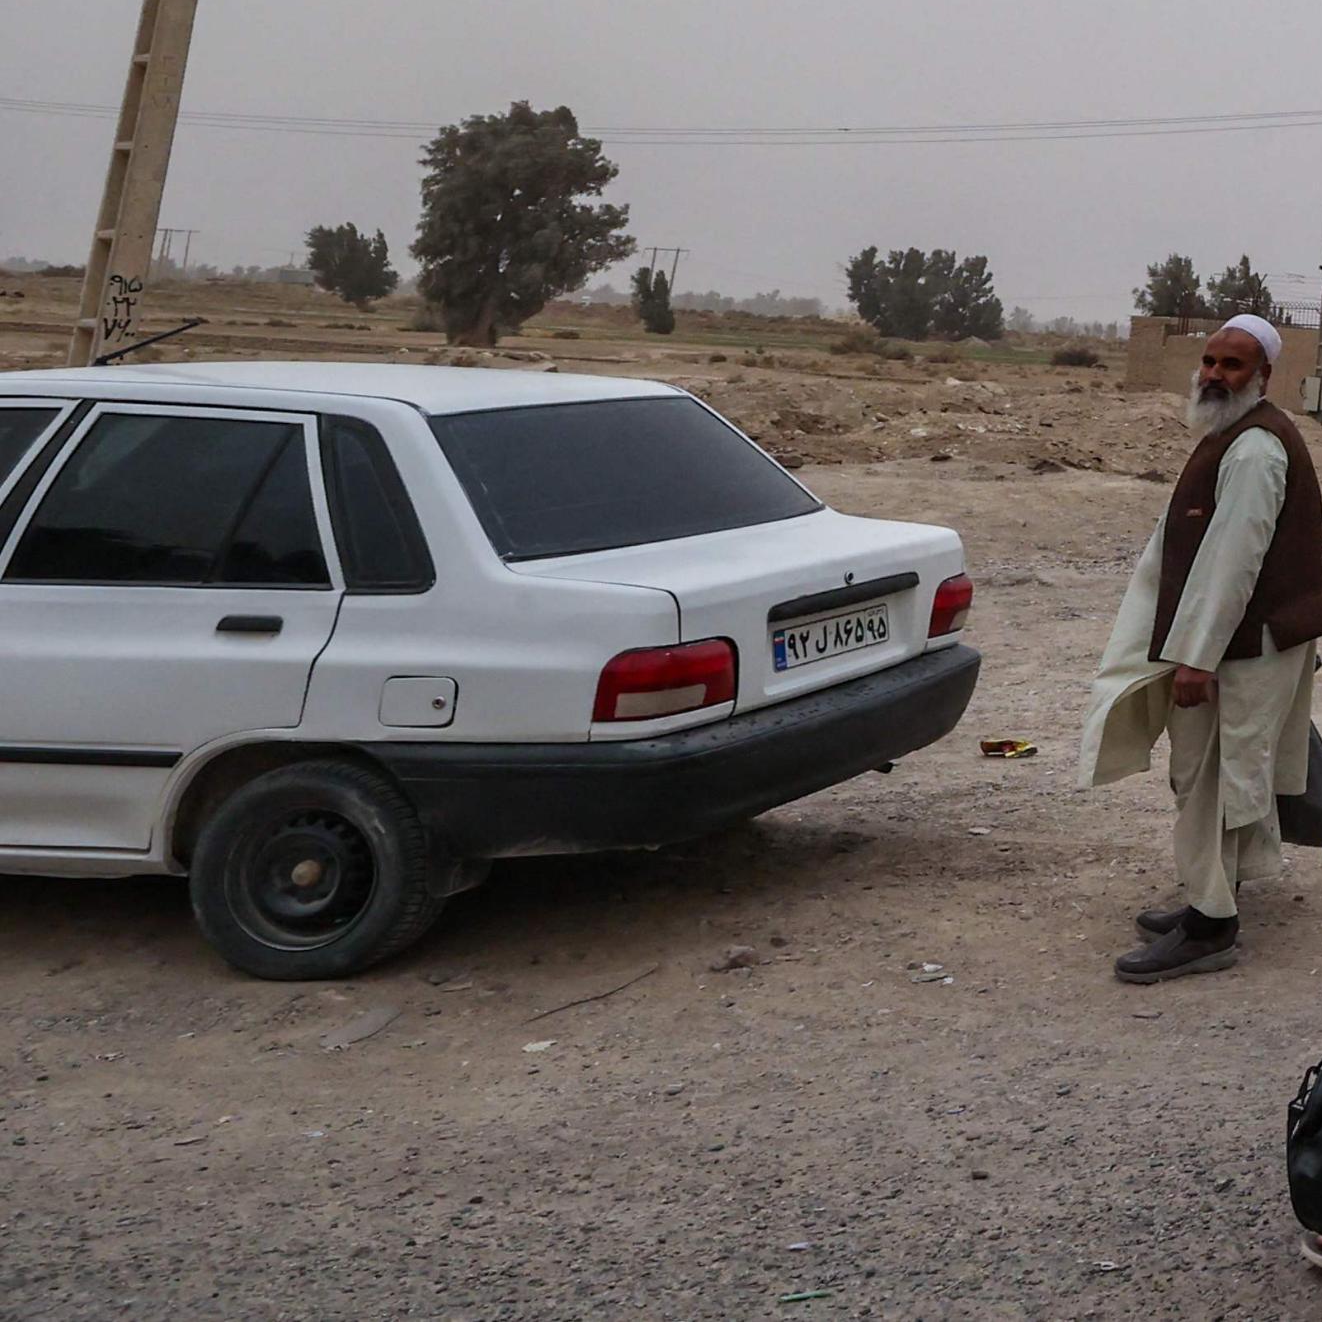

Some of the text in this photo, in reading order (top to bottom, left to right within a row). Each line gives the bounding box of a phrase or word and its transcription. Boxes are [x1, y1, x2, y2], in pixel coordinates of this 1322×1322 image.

[787, 616, 887, 660] ۹۲ ل ۸۶۵ ۹۵
